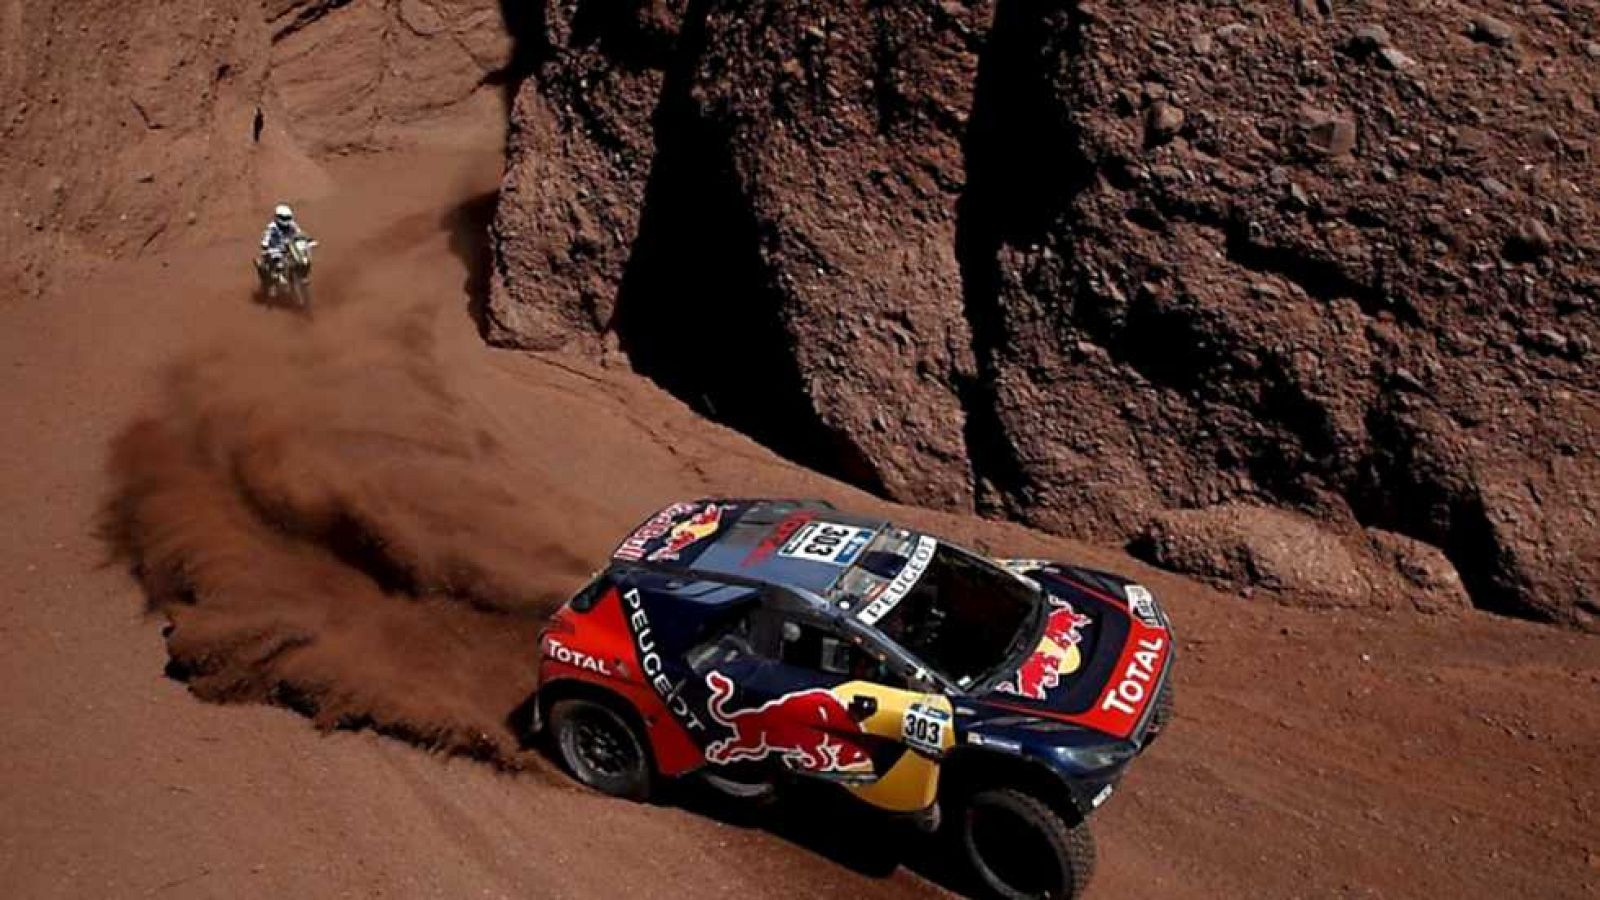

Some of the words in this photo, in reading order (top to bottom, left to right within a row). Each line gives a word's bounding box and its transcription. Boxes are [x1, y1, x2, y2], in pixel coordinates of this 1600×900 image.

[804, 525, 849, 556] 303
[866, 540, 934, 618] PEUGEOT
[548, 638, 611, 676] TOTAL
[1101, 637, 1164, 714] TOTAL
[906, 713, 940, 744] 303
